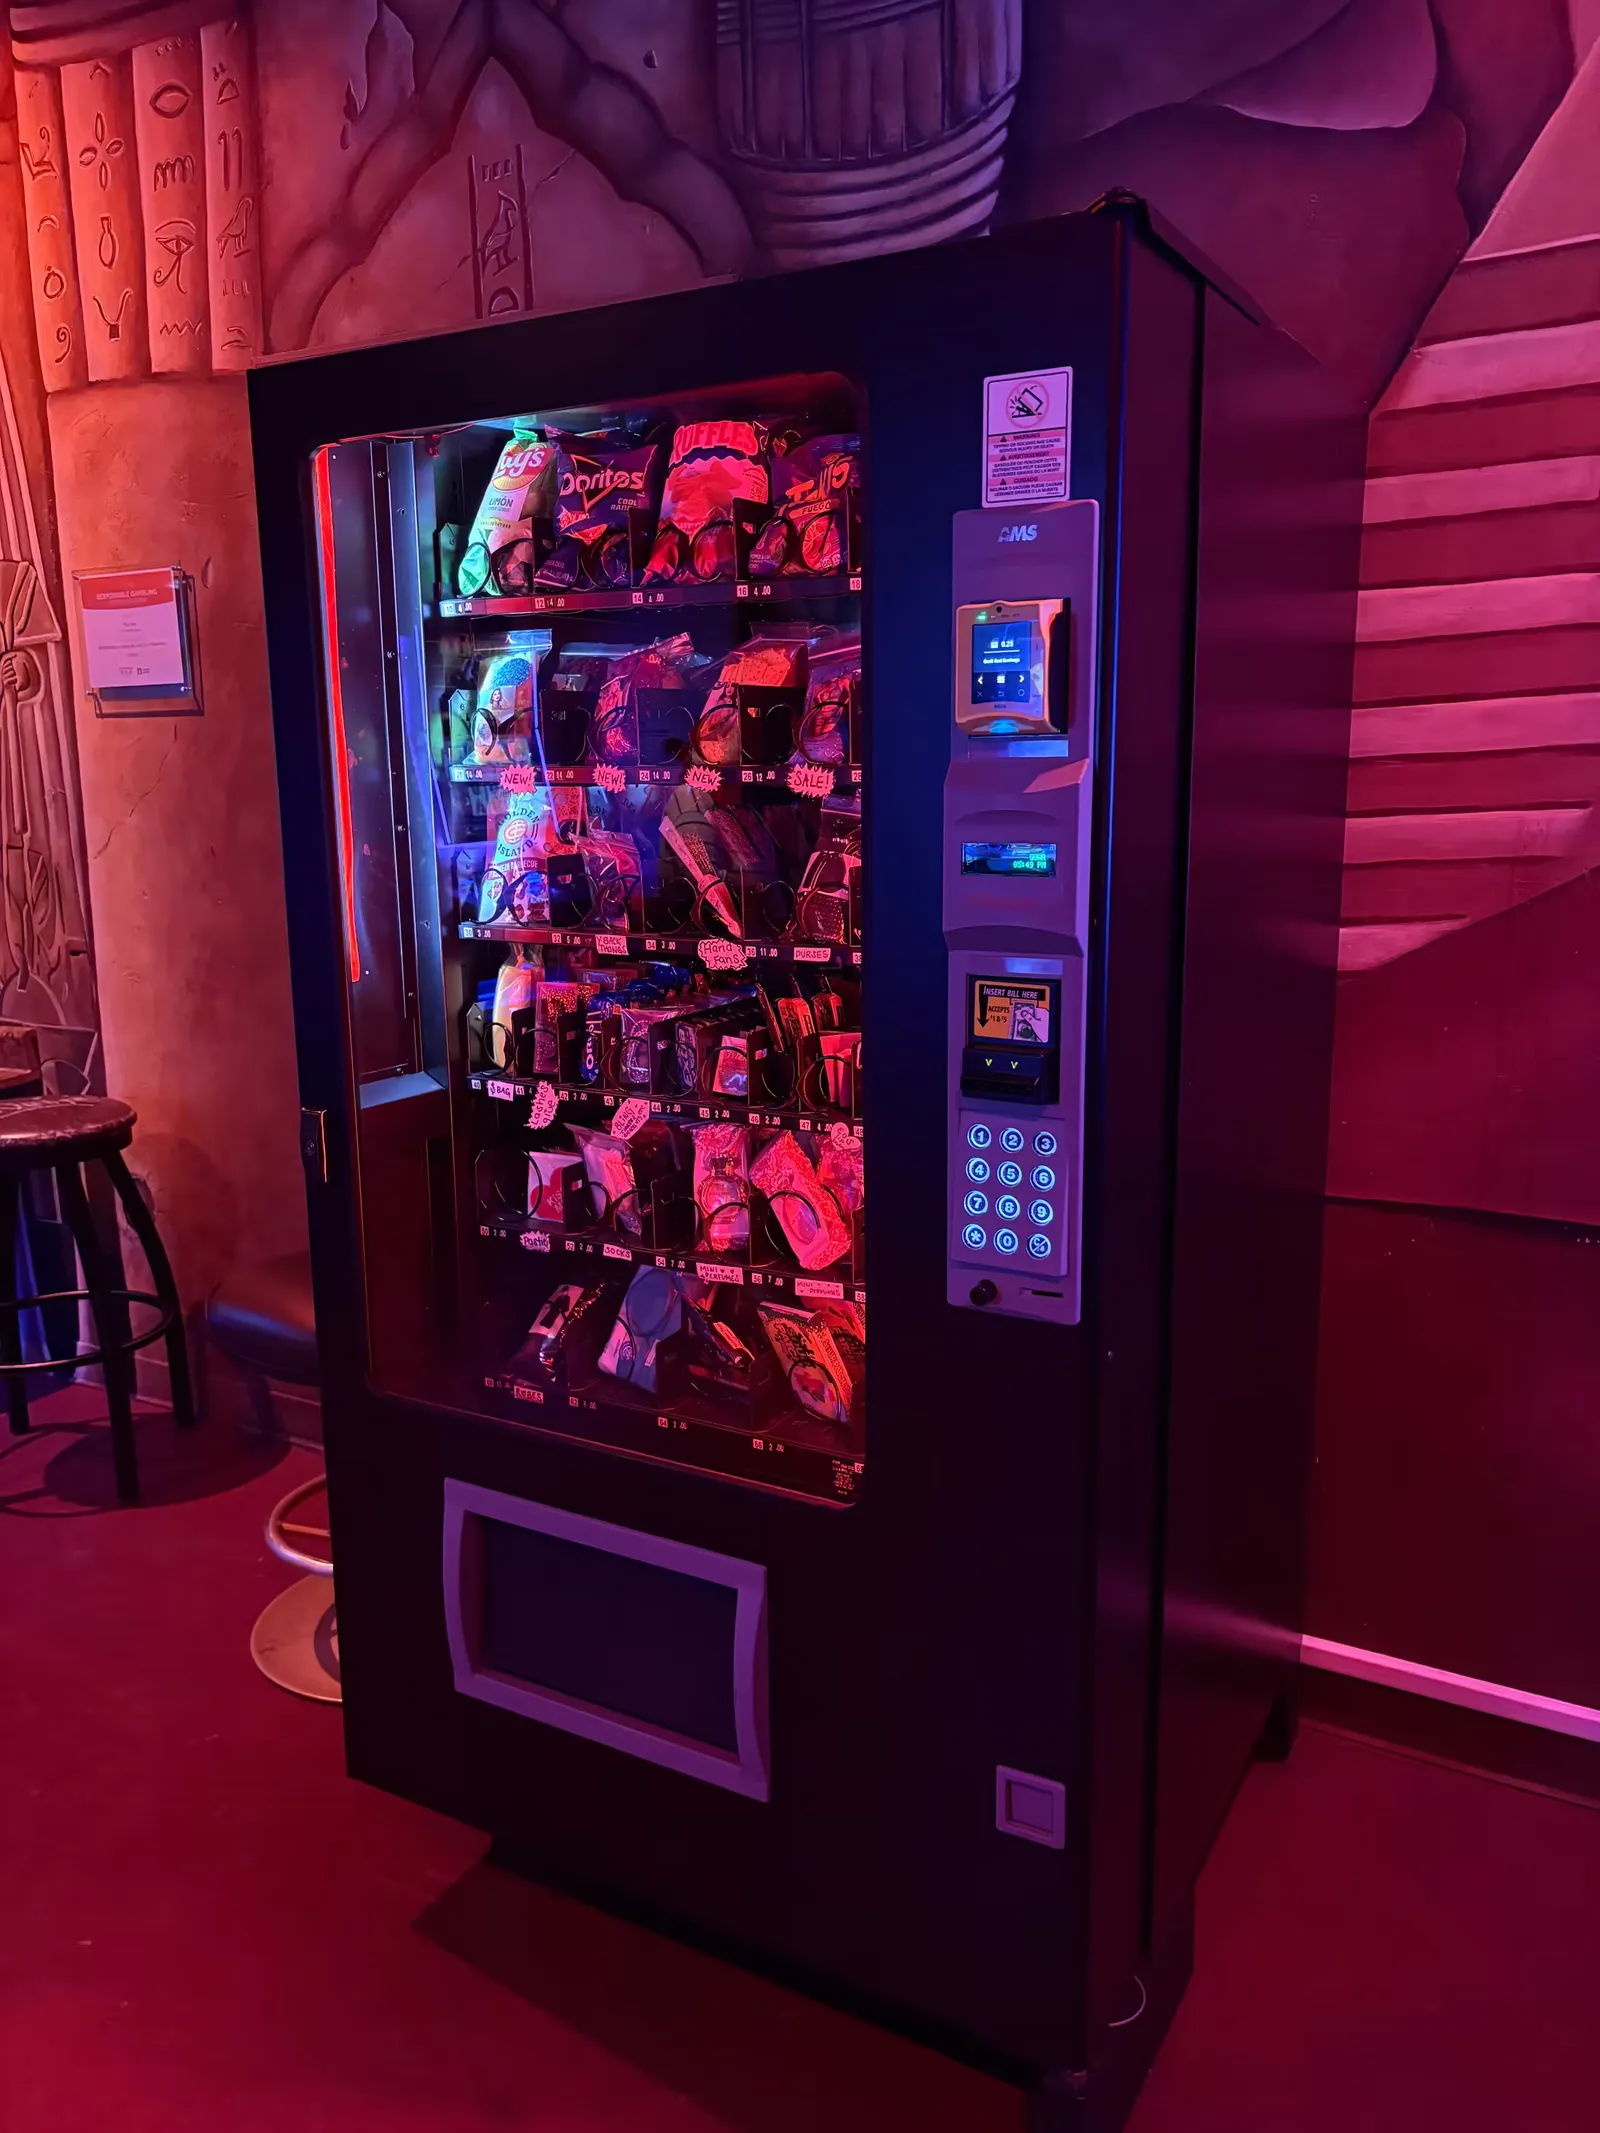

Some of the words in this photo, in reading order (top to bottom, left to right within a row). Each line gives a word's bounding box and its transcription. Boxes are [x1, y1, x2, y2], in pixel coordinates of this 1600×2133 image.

[668, 421, 758, 466] RUFFLES
[496, 446, 544, 478] Lay's
[560, 468, 644, 496] Doritos
[488, 496, 514, 507] LIMÓN
[618, 498, 638, 506] COOL
[801, 500, 832, 514] FUEGO
[851, 580, 861, 589] 18
[738, 587, 747, 596] 16
[504, 772, 533, 787] NEW!
[597, 771, 623, 789] NEW!
[641, 772, 649, 780] 24
[692, 772, 717, 786] NEW
[743, 772, 753, 781] 26
[794, 770, 830, 789] SALE!
[553, 934, 562, 943] 32
[646, 941, 656, 950] 34
[703, 942, 733, 954] Hand
[713, 953, 741, 965] Fans
[795, 949, 829, 960] PURSES
[983, 985, 1006, 996] INSERT
[1006, 989, 1020, 998] BILL
[1021, 991, 1039, 999] HERE
[988, 1005, 1010, 1014] ACCEPTS
[516, 1087, 524, 1095] 41
[560, 1092, 569, 1100] 42
[531, 1084, 549, 1126] Lashes
[614, 1106, 636, 1131] BLING
[700, 1109, 710, 1118] 45
[750, 1115, 760, 1124] 46
[800, 1120, 810, 1129] 47
[977, 1130, 984, 1143] 1
[1008, 1134, 1019, 1146] 2
[1041, 1138, 1051, 1150] 3
[974, 1164, 984, 1176] 4
[1006, 1168, 1016, 1180] 5
[1038, 1172, 1049, 1184] 6
[546, 1189, 562, 1207] KIS
[973, 1197, 983, 1209] 7
[1004, 1201, 1015, 1213] 8
[1037, 1206, 1047, 1218] 9
[1004, 1235, 1012, 1247] 0
[604, 1246, 631, 1258] SOCKS
[699, 1265, 718, 1274] MINI
[705, 1272, 740, 1283] PERFUMES
[753, 1275, 762, 1283] 56
[658, 1418, 668, 1427] 64
